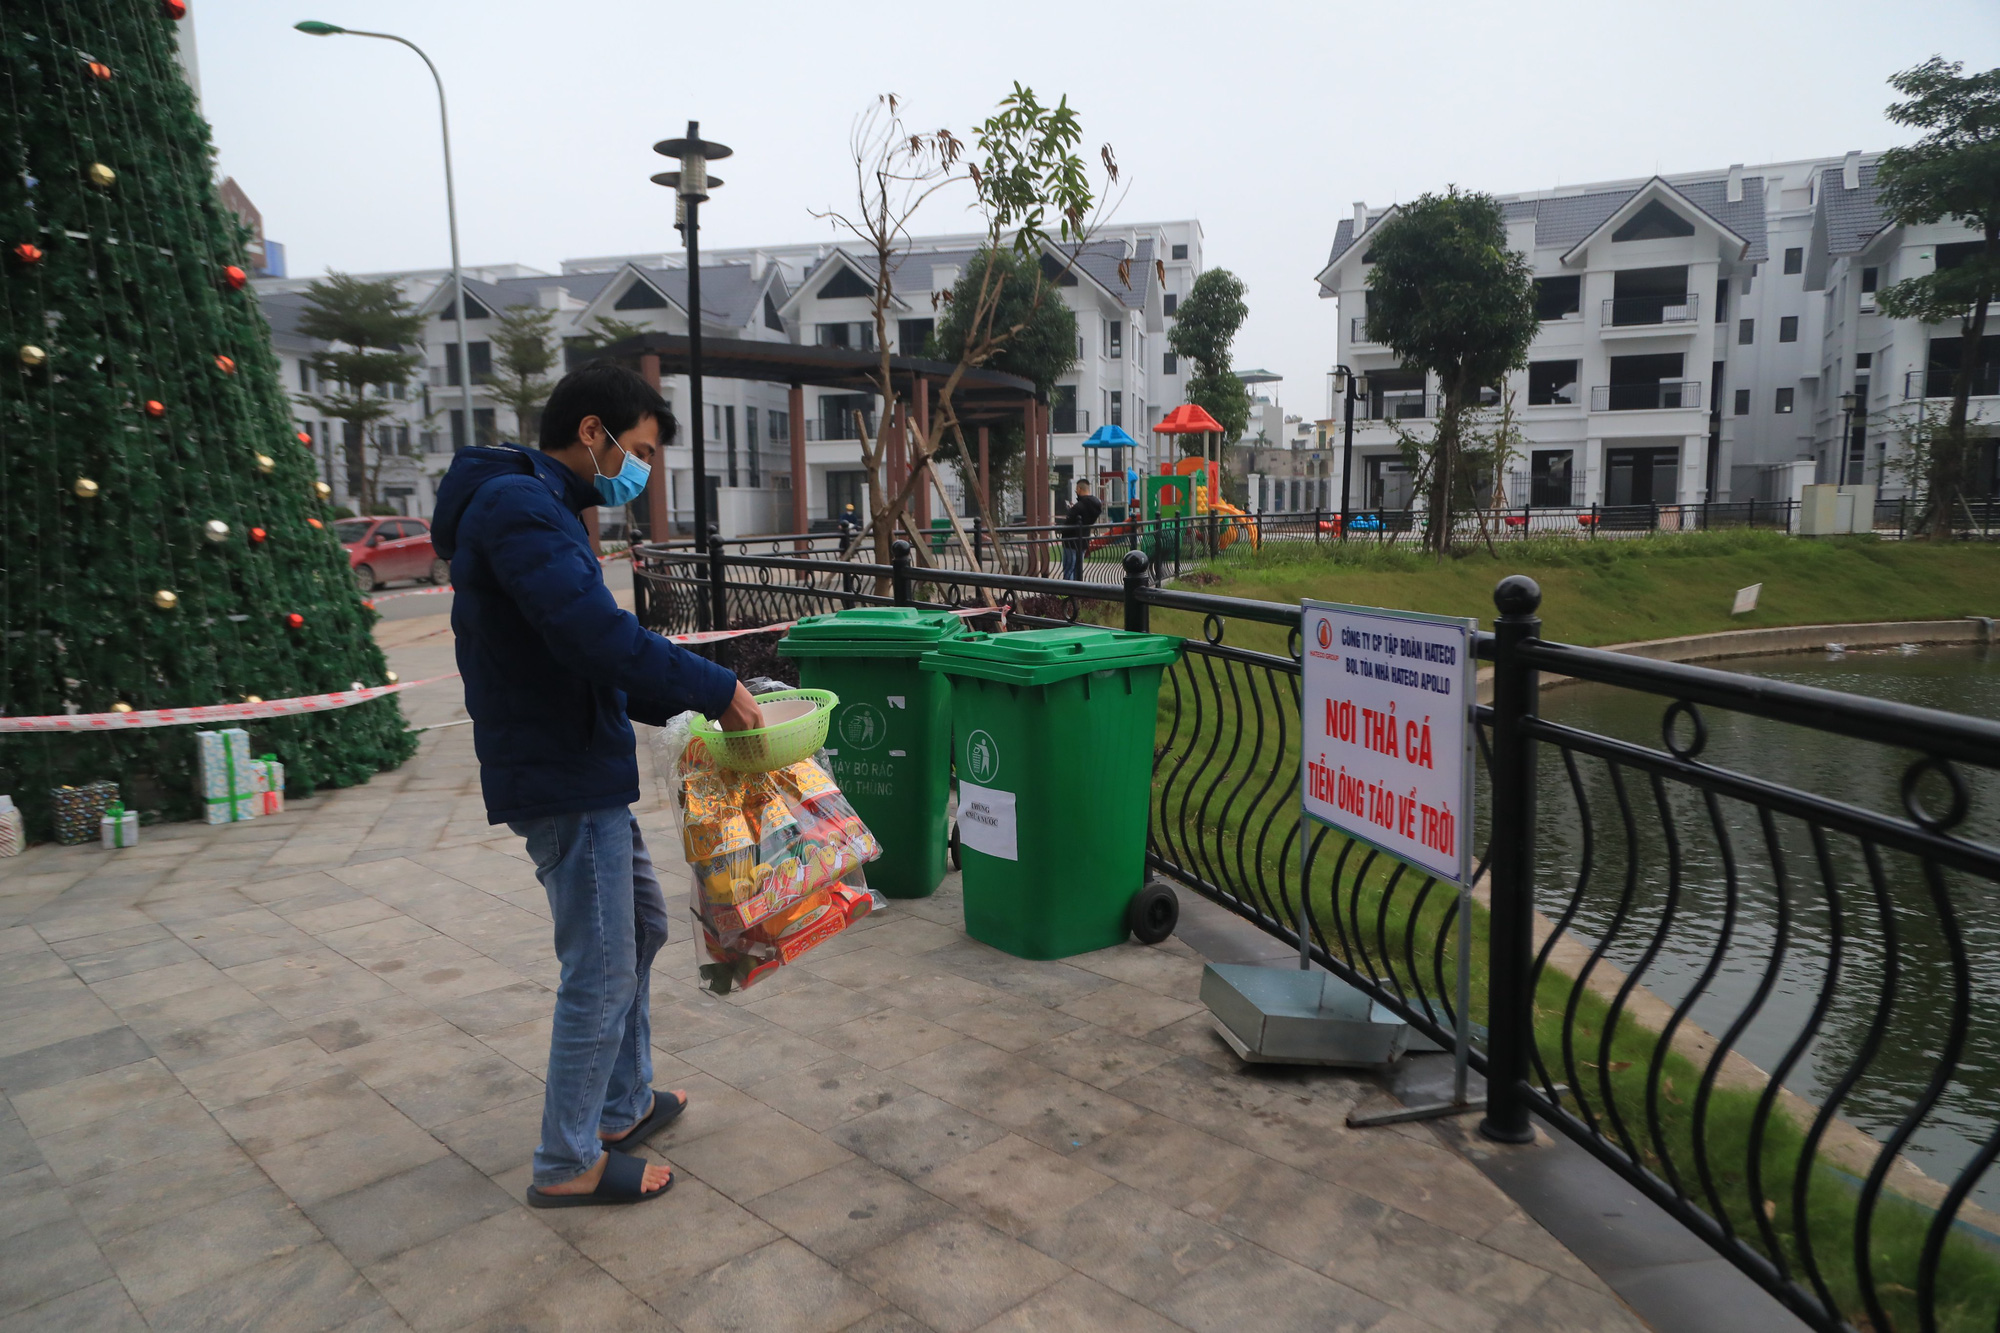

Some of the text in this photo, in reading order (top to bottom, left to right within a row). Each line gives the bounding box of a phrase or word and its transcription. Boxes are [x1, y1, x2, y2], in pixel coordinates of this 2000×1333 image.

[1342, 626, 1456, 666] CÔNG TY CP TẬP ĐOÀN HATECO
[1346, 657, 1450, 695] BQL TÒA NHÀ HATECO APOLLO
[1326, 698, 1433, 770] NƠI THẢ CÁ
[836, 776, 893, 795] ÀO THÙNG
[872, 760, 893, 777] RÁC
[1308, 753, 1454, 857] TIỄN ÔNG TÁO VỀ TRỜI
